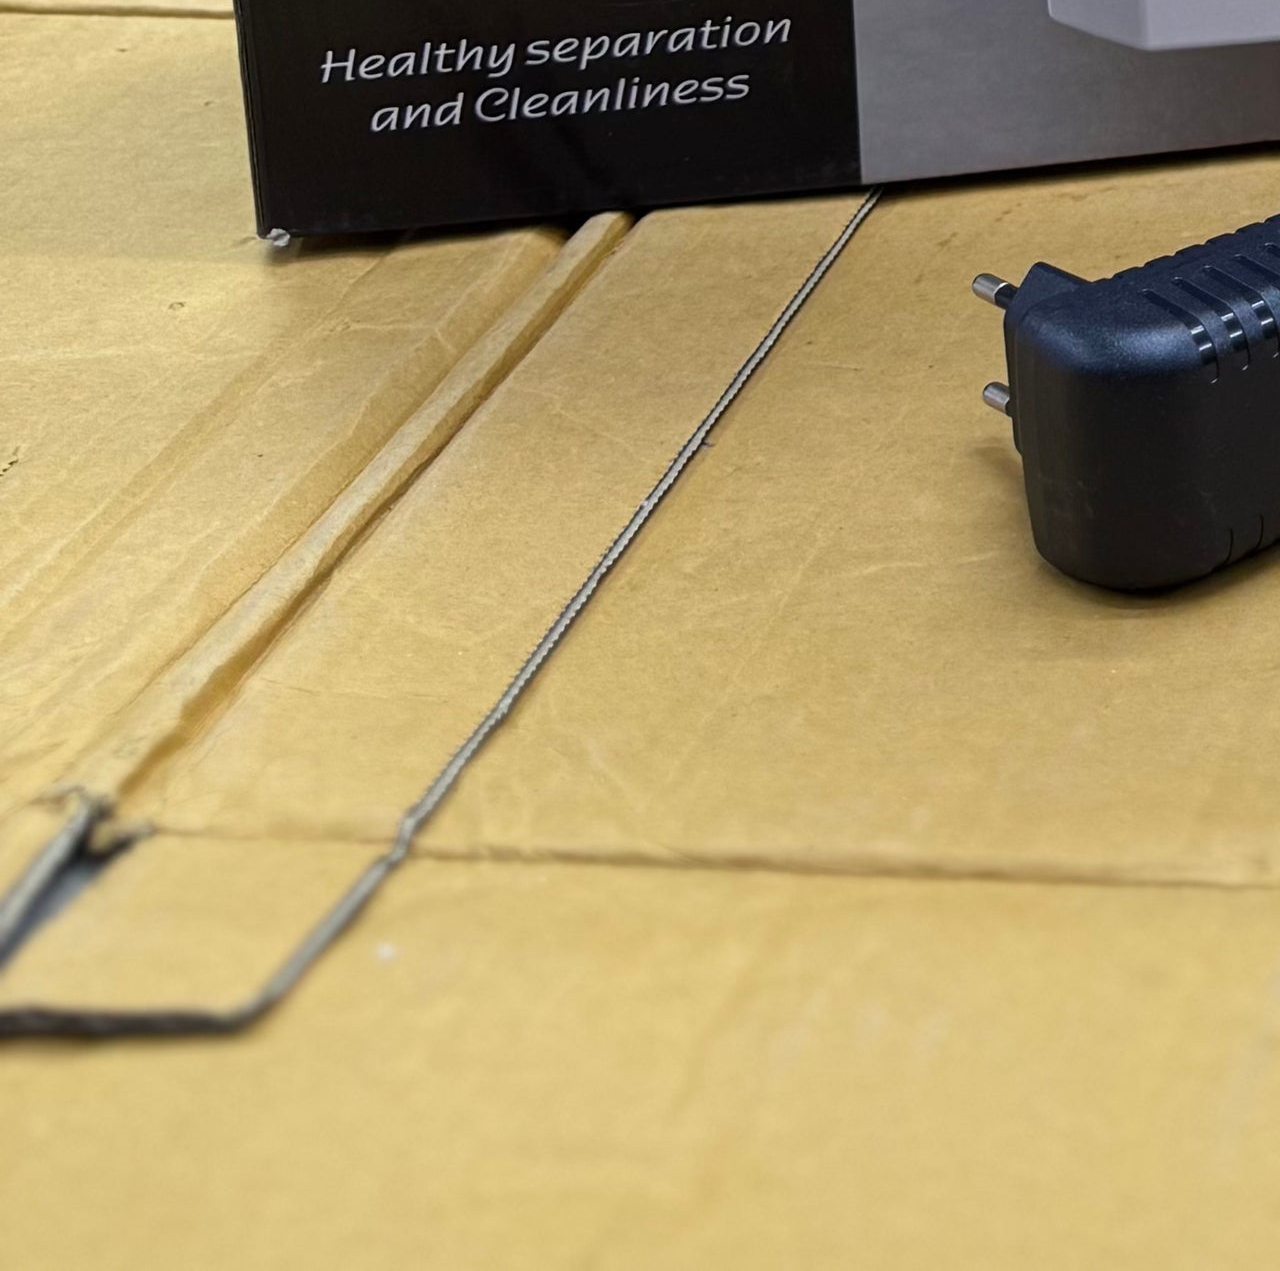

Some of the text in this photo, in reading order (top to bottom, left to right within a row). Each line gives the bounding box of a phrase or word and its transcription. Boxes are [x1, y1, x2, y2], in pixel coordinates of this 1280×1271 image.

[319, 16, 792, 84] Healthy separation
[370, 72, 751, 133] and Cleanliness
